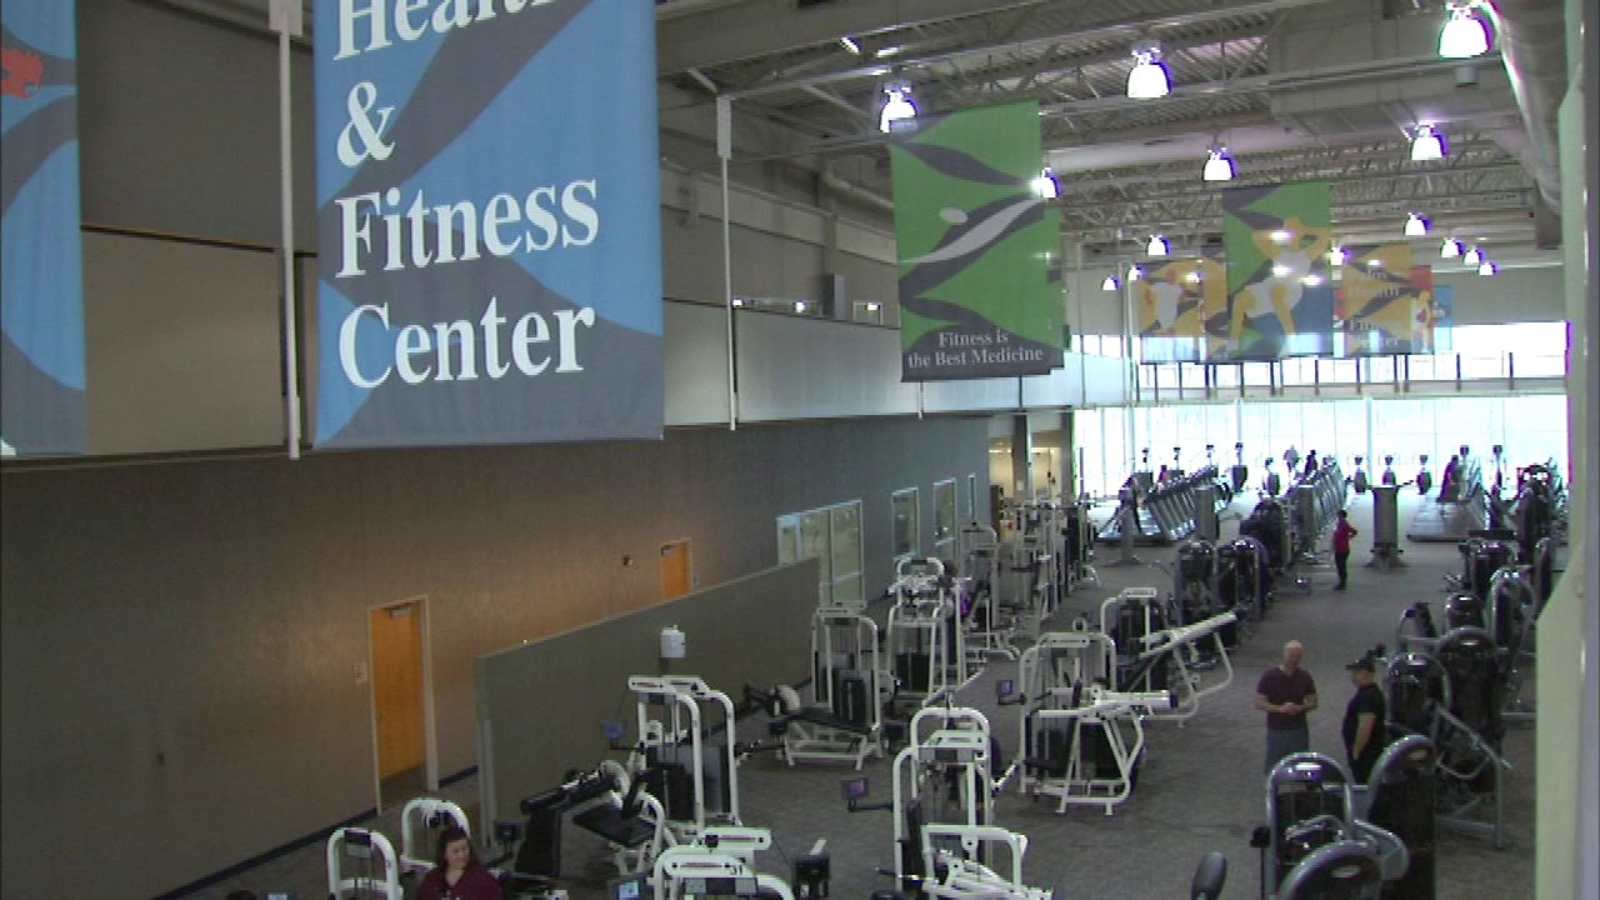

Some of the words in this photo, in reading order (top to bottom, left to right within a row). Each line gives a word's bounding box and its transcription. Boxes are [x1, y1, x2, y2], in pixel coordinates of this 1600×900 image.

[333, 0, 555, 61] Hea
[337, 81, 396, 168] &
[335, 179, 599, 278] Fitness
[339, 296, 595, 389] Center
[908, 353, 931, 368] the
[935, 351, 967, 367] Best
[972, 347, 1043, 364] Medicine
[938, 331, 993, 348] Fitness
[996, 329, 1008, 344] is
